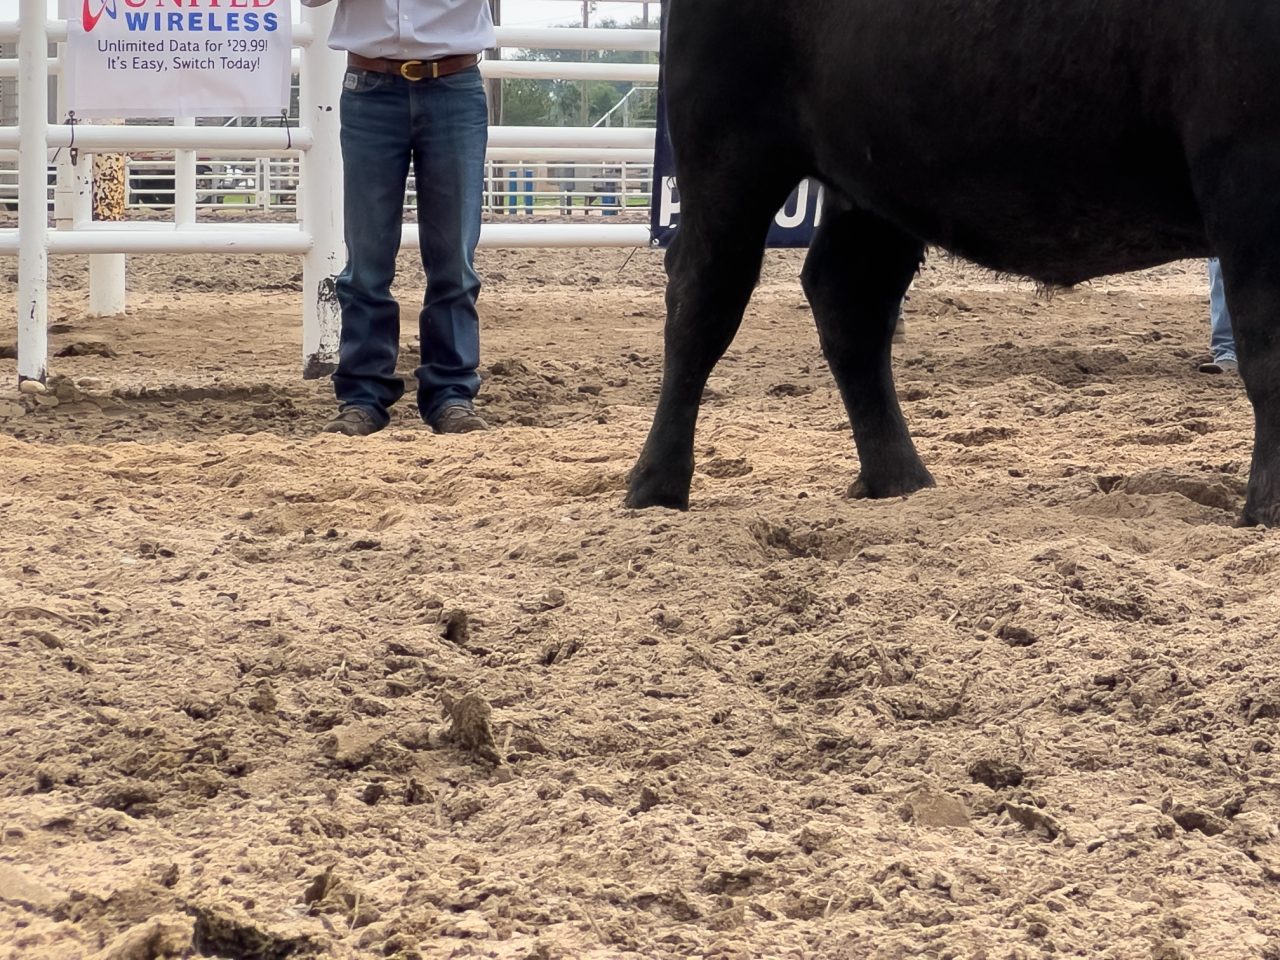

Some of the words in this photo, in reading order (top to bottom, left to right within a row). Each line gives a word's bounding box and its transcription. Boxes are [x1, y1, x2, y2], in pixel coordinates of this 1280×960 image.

[125, 12, 278, 32] WIRELESS
[97, 39, 164, 53] Unlimited
[169, 40, 200, 52] Data
[205, 39, 223, 52] for
[227, 39, 268, 52] $29.99!
[107, 57, 127, 70] It's
[132, 57, 168, 72] Easy,
[172, 57, 214, 70] Switch
[220, 57, 260, 72] Today!
